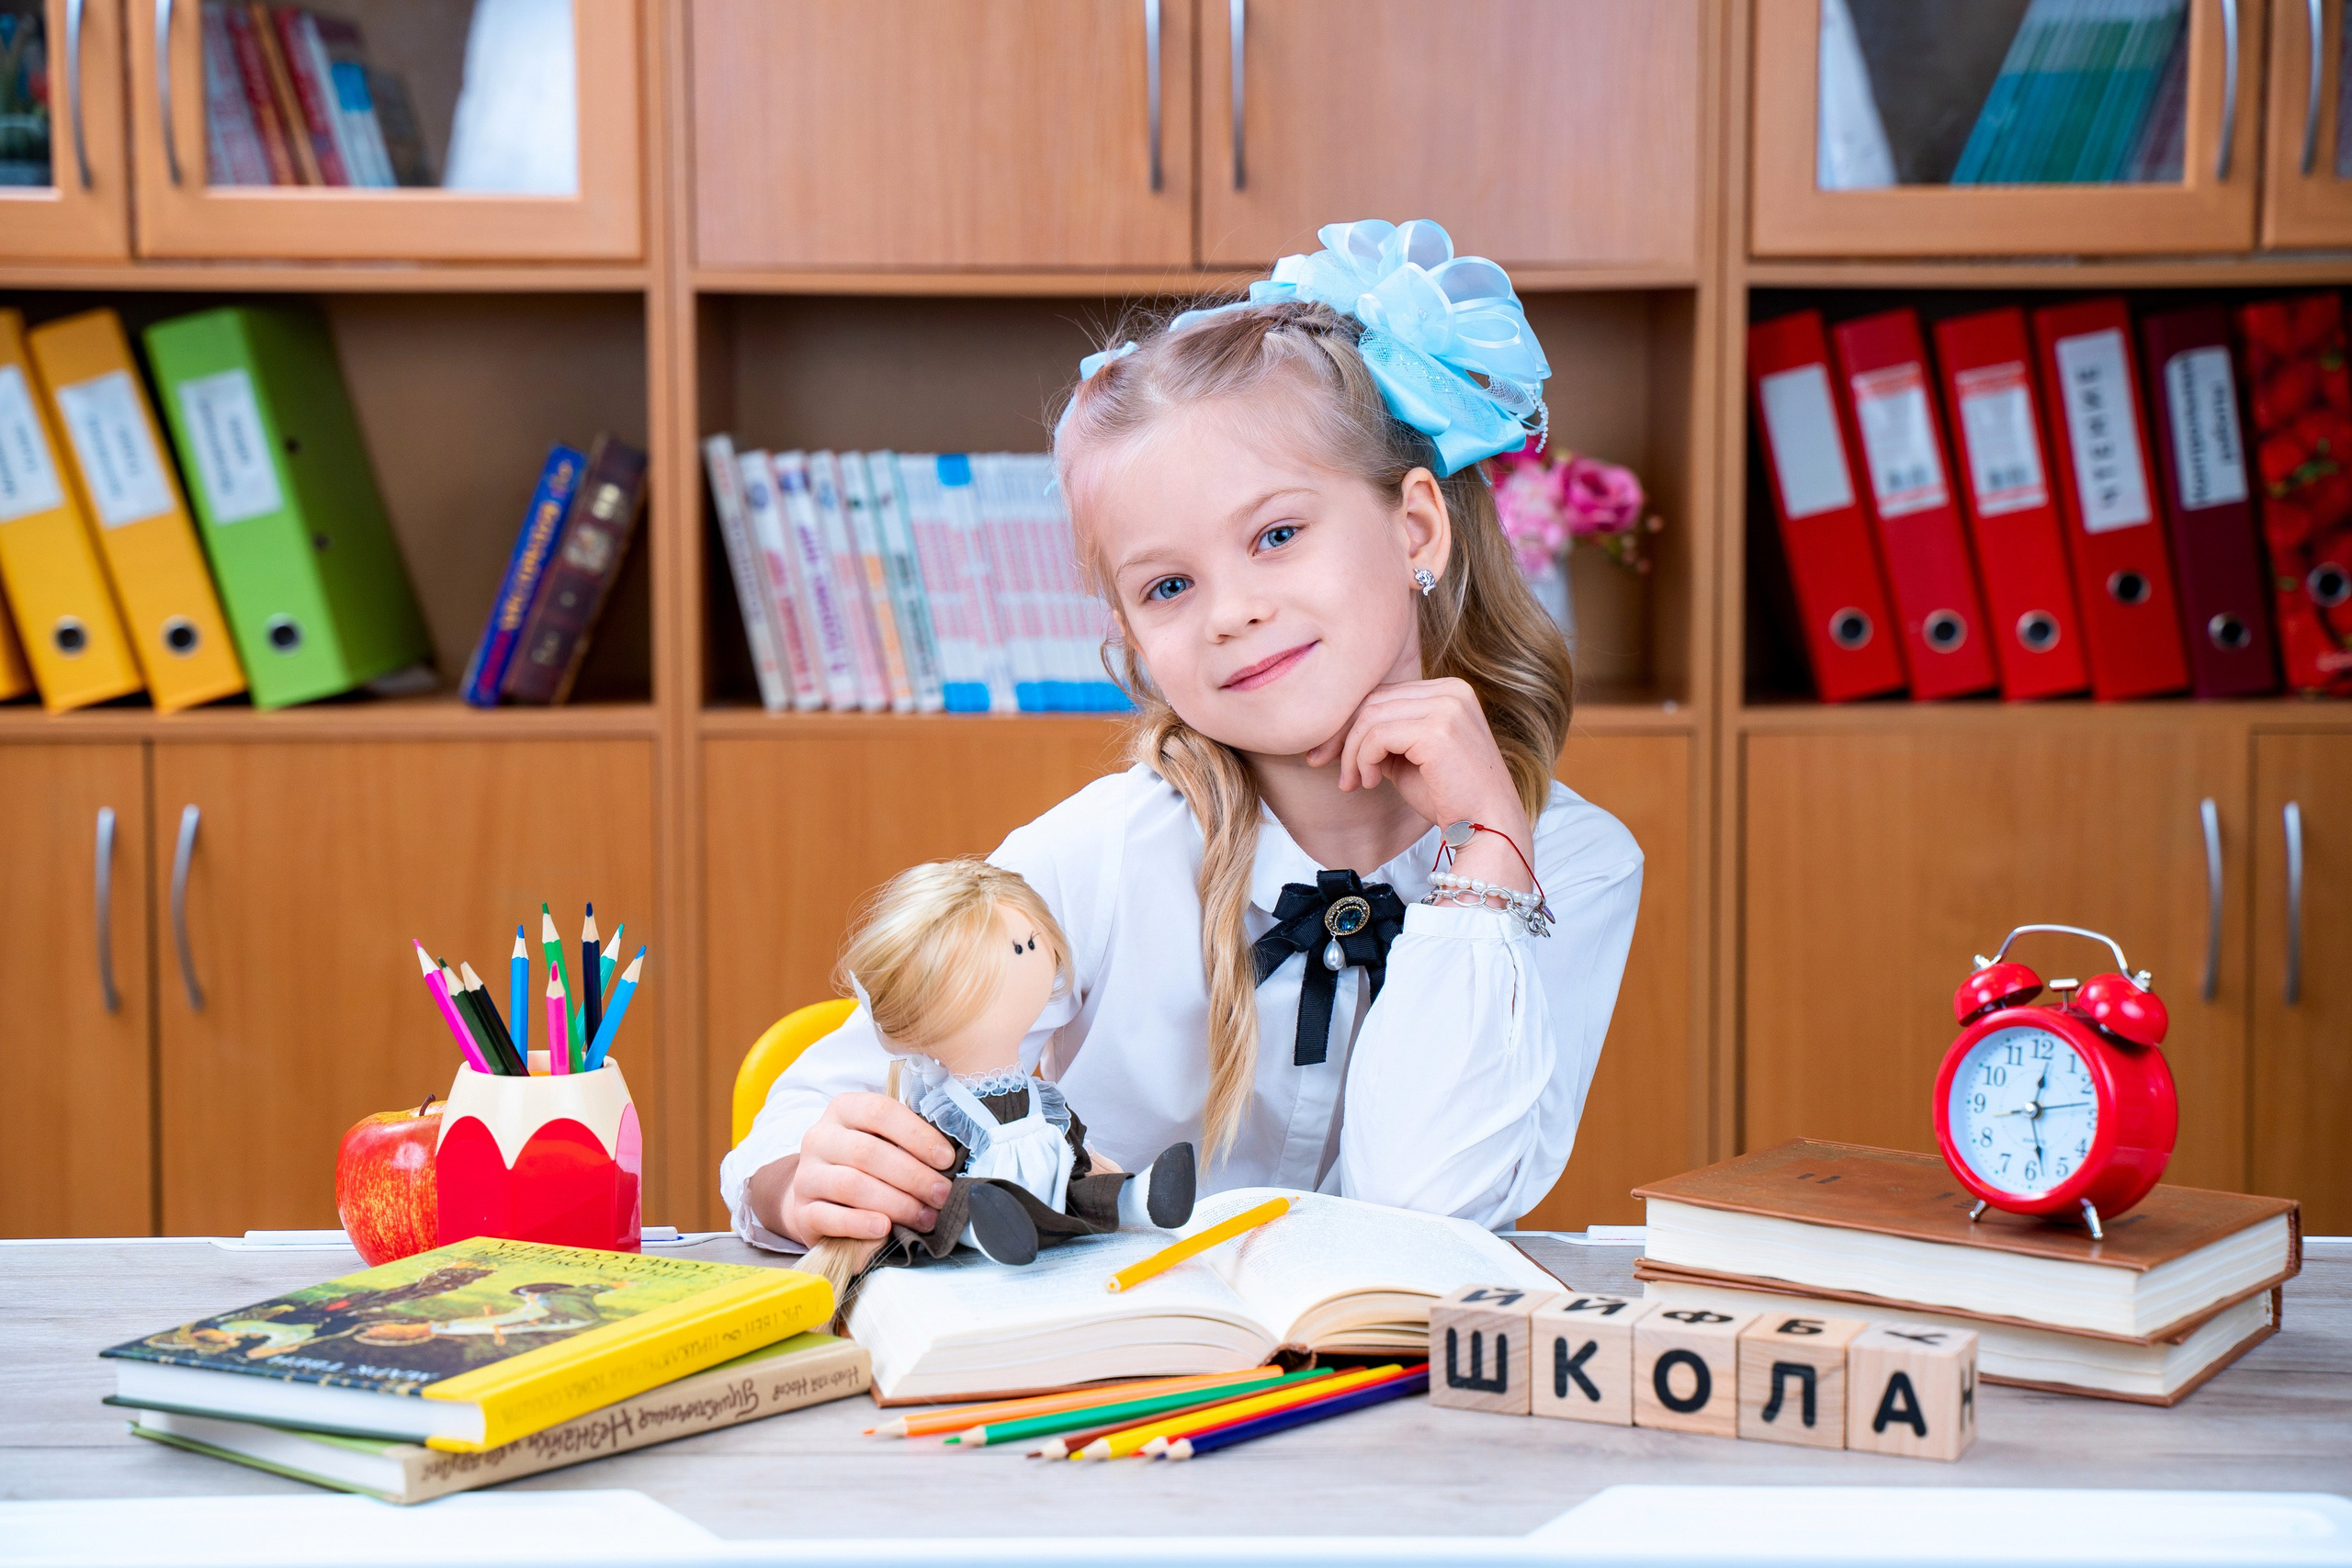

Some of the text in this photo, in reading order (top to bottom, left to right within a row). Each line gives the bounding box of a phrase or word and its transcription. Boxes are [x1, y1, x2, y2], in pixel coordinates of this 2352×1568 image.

[2005, 1044, 2023, 1066] 11
[2030, 1038, 2054, 1060] 12
[2067, 1054, 2077, 1074] 1
[1983, 1065, 2007, 1087] 10
[2080, 1073, 2095, 1095] 2
[1973, 1093, 1986, 1113] 9
[2086, 1108, 2098, 1130] 3
[1979, 1126, 1994, 1148] 8
[2074, 1137, 2087, 1158] 4
[2000, 1153, 2012, 1174] 7
[2024, 1159, 2037, 1181] 6
[2055, 1157, 2069, 1178] 5
[628, 1256, 715, 1273] ТОМА
[1662, 1310, 1734, 1325] Ф
[1776, 1318, 1826, 1335] Б
[1445, 1325, 1928, 1438] ШКОЛА
